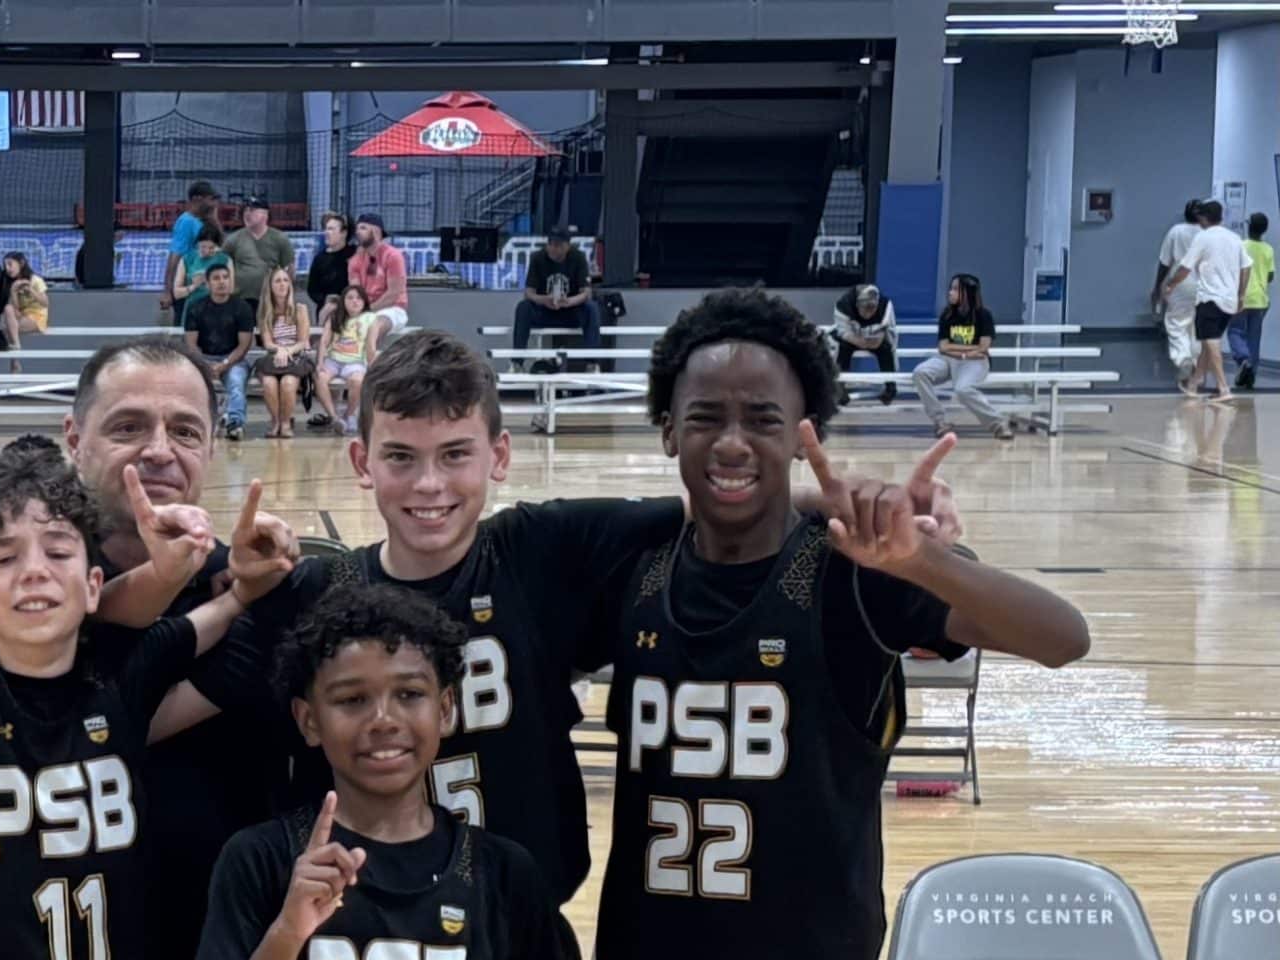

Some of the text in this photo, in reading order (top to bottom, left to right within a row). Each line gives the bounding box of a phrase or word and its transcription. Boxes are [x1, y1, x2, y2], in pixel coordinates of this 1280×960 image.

[629, 675, 789, 780] PSB
[430, 752, 486, 830] 5
[645, 794, 754, 900] 22
[931, 892, 1114, 903] VIRGINIA BEACH
[933, 908, 1114, 925] SPORTS CENTER
